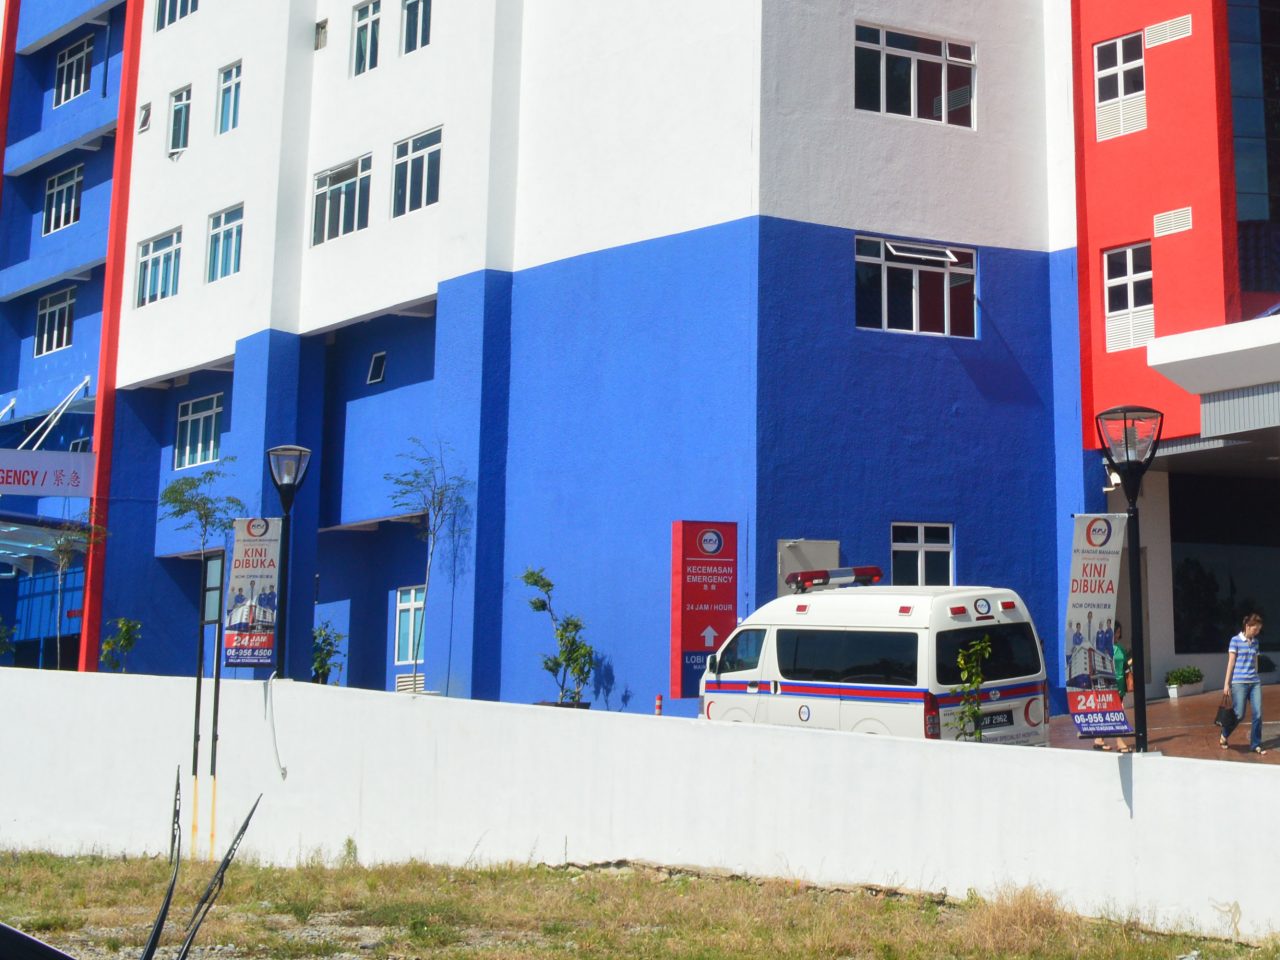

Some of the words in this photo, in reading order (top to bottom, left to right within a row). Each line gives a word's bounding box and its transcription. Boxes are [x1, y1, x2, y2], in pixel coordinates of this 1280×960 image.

[244, 548, 267, 558] KINI
[234, 558, 276, 569] DIBUKA
[687, 566, 733, 574] KECEMASAN
[1082, 563, 1107, 578] KINI
[687, 575, 733, 583] EMERGENCY
[1071, 579, 1115, 594] DIBUKA
[233, 636, 249, 647] 24
[1077, 694, 1096, 710] 24
[1097, 693, 1113, 702] JAM
[1074, 713, 1104, 724] 06-956
[1105, 712, 1125, 722] 4500
